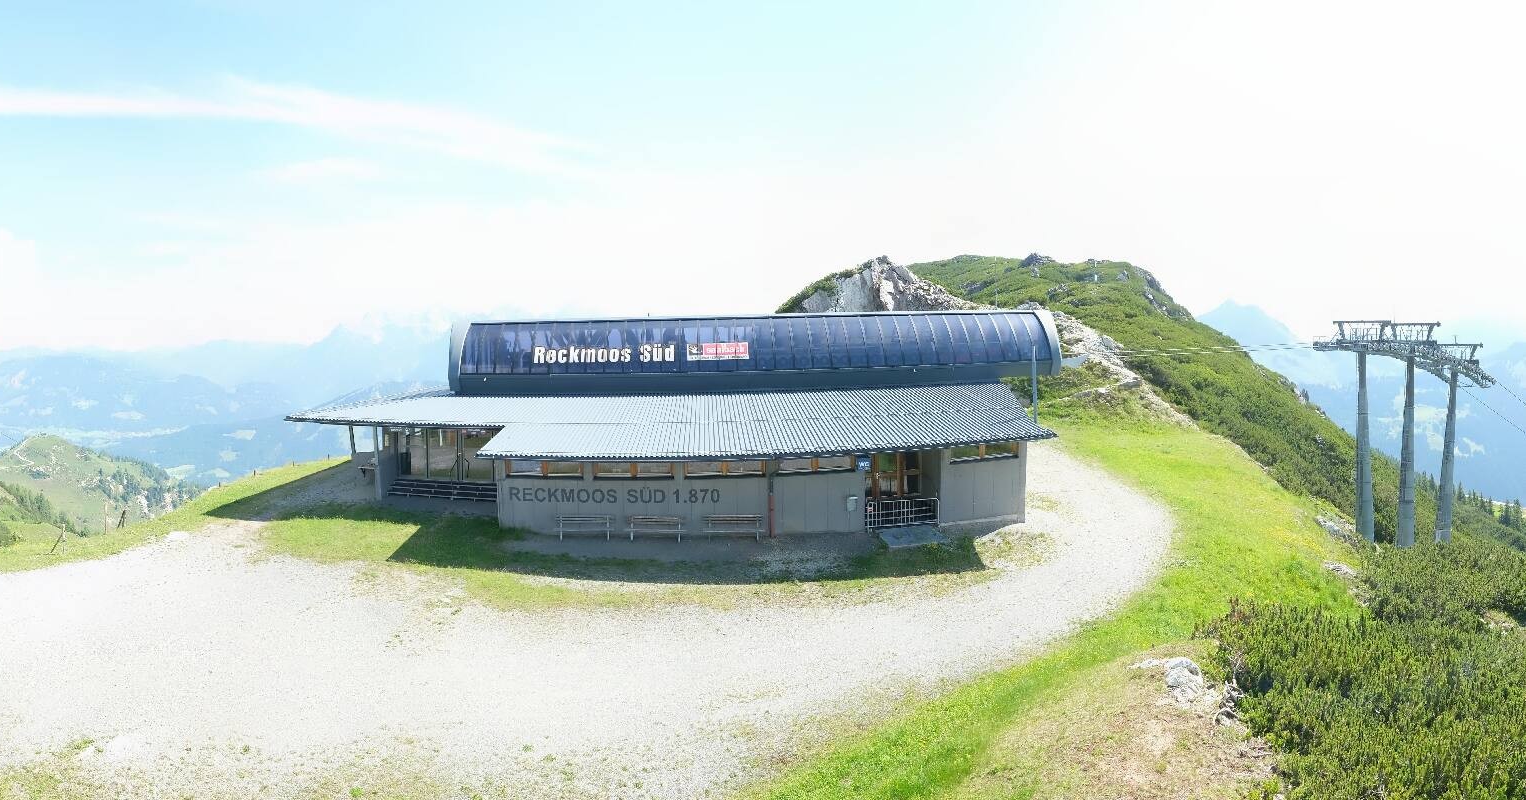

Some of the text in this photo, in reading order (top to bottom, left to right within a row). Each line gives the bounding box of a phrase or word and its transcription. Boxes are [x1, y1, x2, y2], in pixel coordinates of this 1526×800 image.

[533, 343, 675, 364] Reckmoos Süd
[508, 486, 721, 504] RECKMOOS SÜD 1.870
